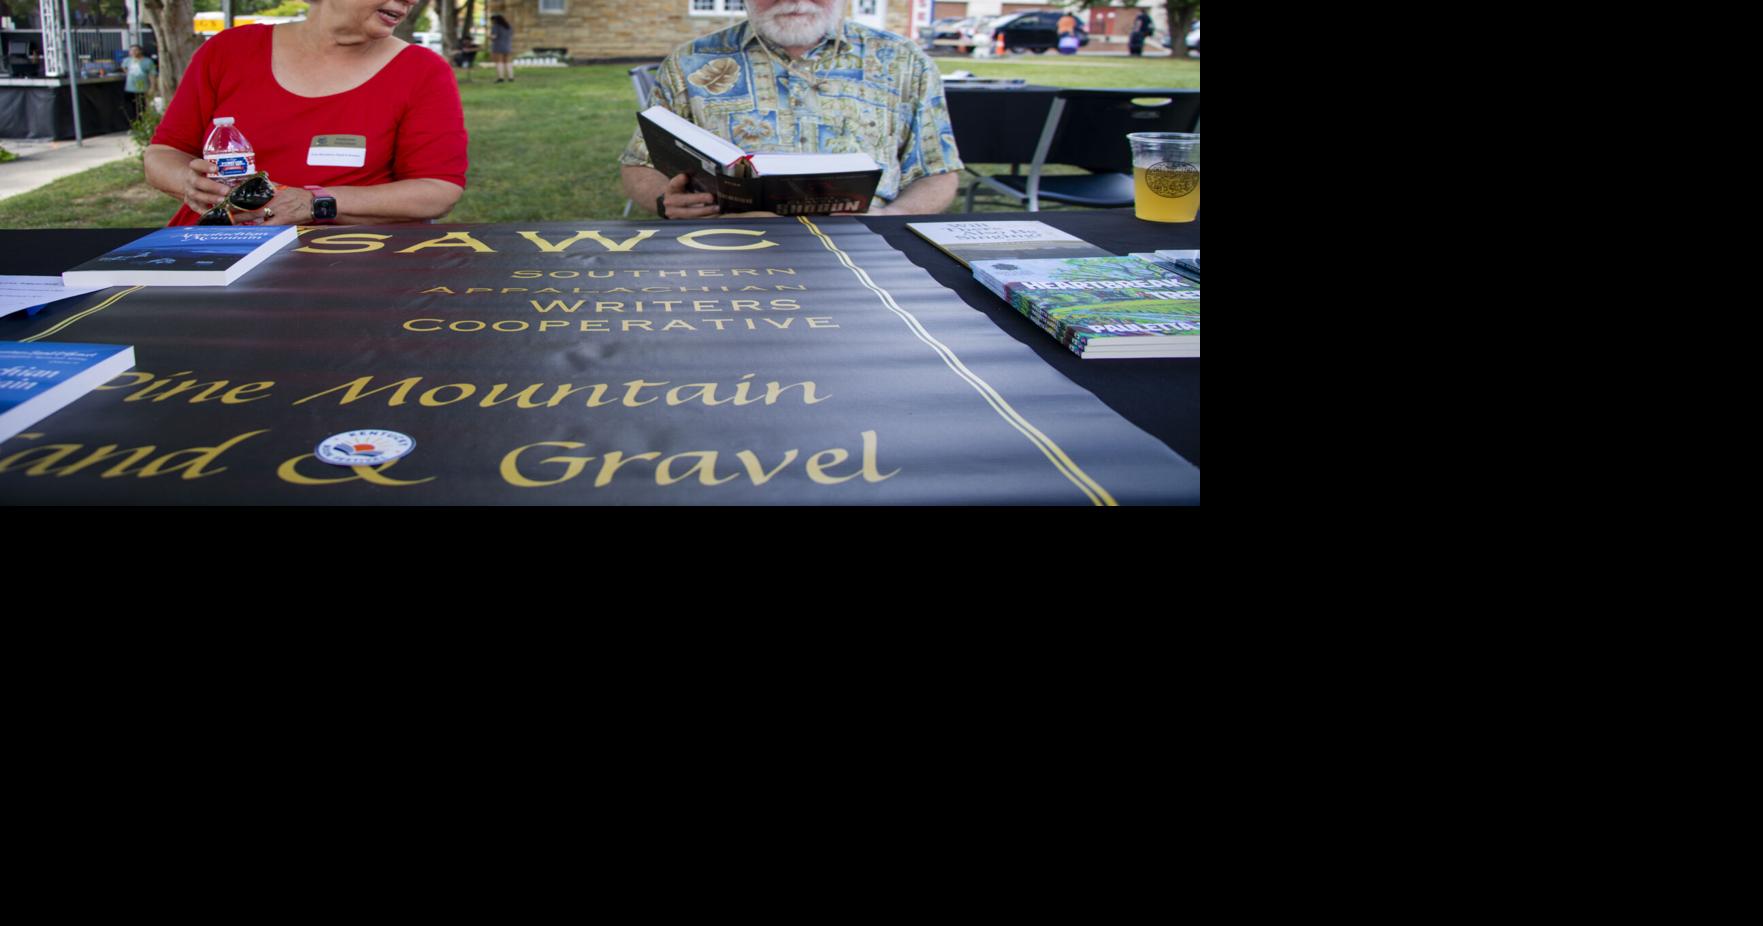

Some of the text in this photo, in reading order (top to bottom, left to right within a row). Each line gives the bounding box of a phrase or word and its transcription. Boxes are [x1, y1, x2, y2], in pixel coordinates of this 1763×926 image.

[292, 228, 780, 253] SAWC
[510, 267, 797, 279] SOUTHERN
[419, 284, 807, 294] APPALACHIAN
[1021, 278, 1190, 290] HEARTBREAK
[1145, 290, 1200, 300] TRE
[528, 299, 802, 312] WRITERS
[402, 316, 841, 332] COOPERATIVE
[1087, 322, 1196, 334] PAULETTA
[293, 372, 832, 407] Mountain
[0, 429, 270, 480] and
[500, 430, 901, 487] Gravel
